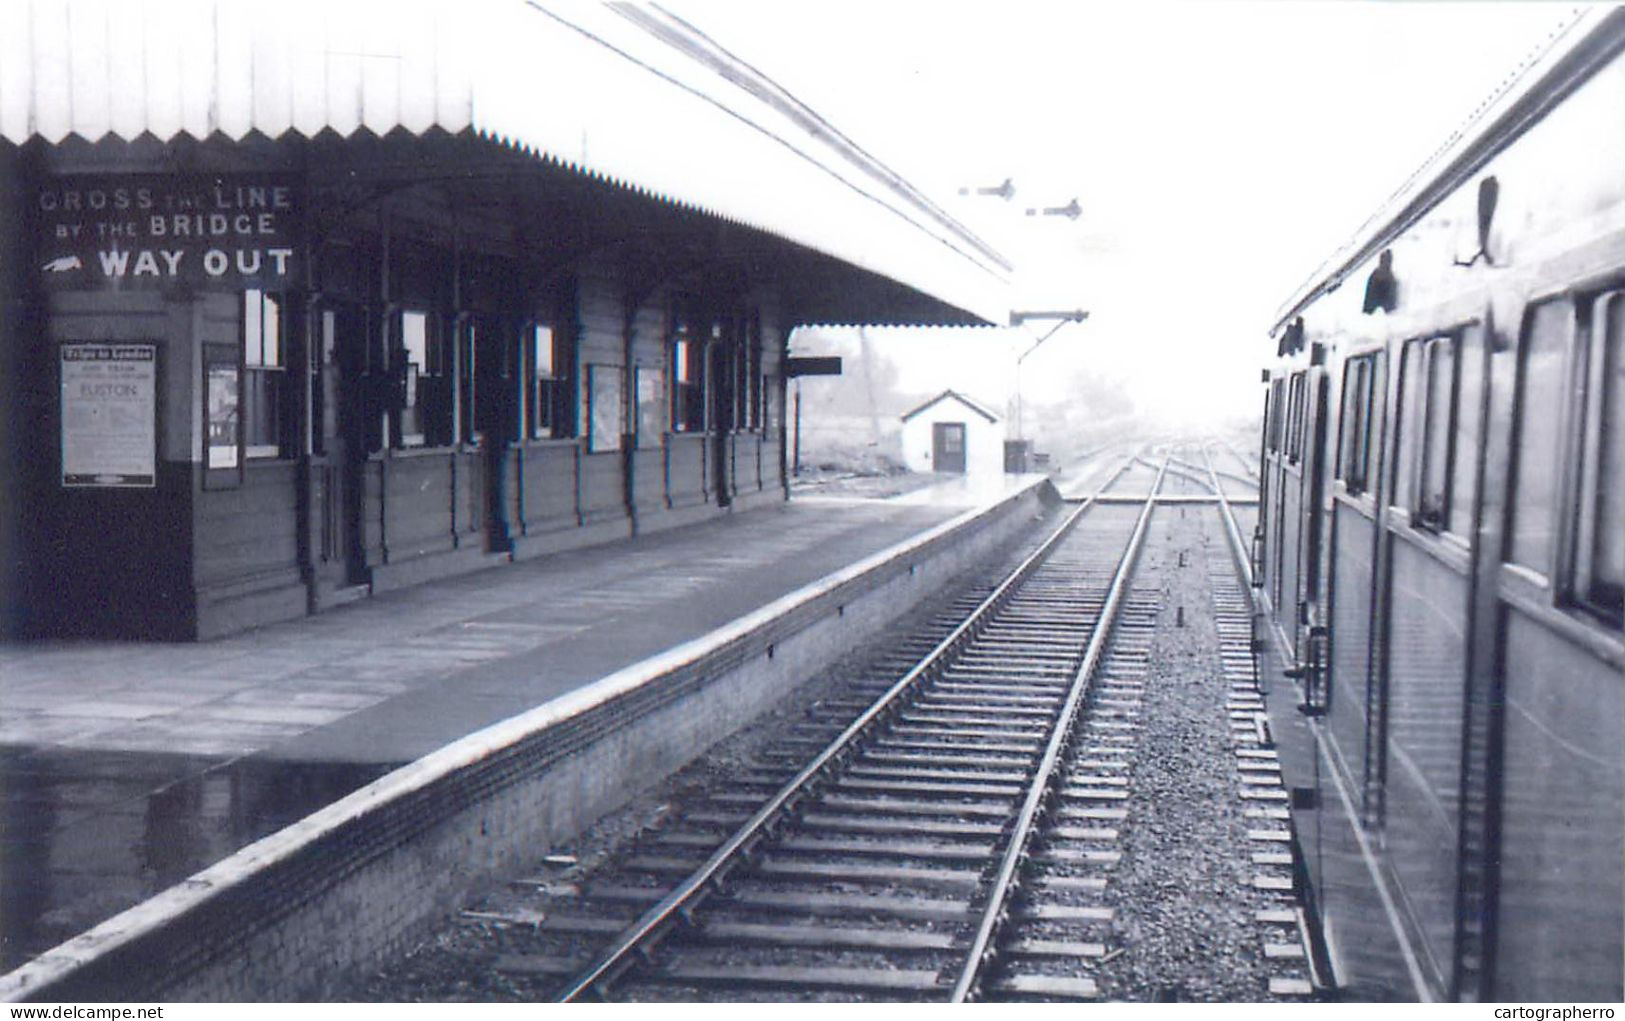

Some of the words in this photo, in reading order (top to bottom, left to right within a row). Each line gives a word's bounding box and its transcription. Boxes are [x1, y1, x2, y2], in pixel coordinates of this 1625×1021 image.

[40, 187, 152, 210] CROSS
[216, 184, 290, 208] LINE
[56, 222, 82, 238] BY
[98, 220, 137, 237] THE
[150, 213, 276, 236] BRIDGE
[98, 249, 184, 276] WAY
[203, 249, 293, 276] OUT
[80, 382, 137, 398] EUSTON
